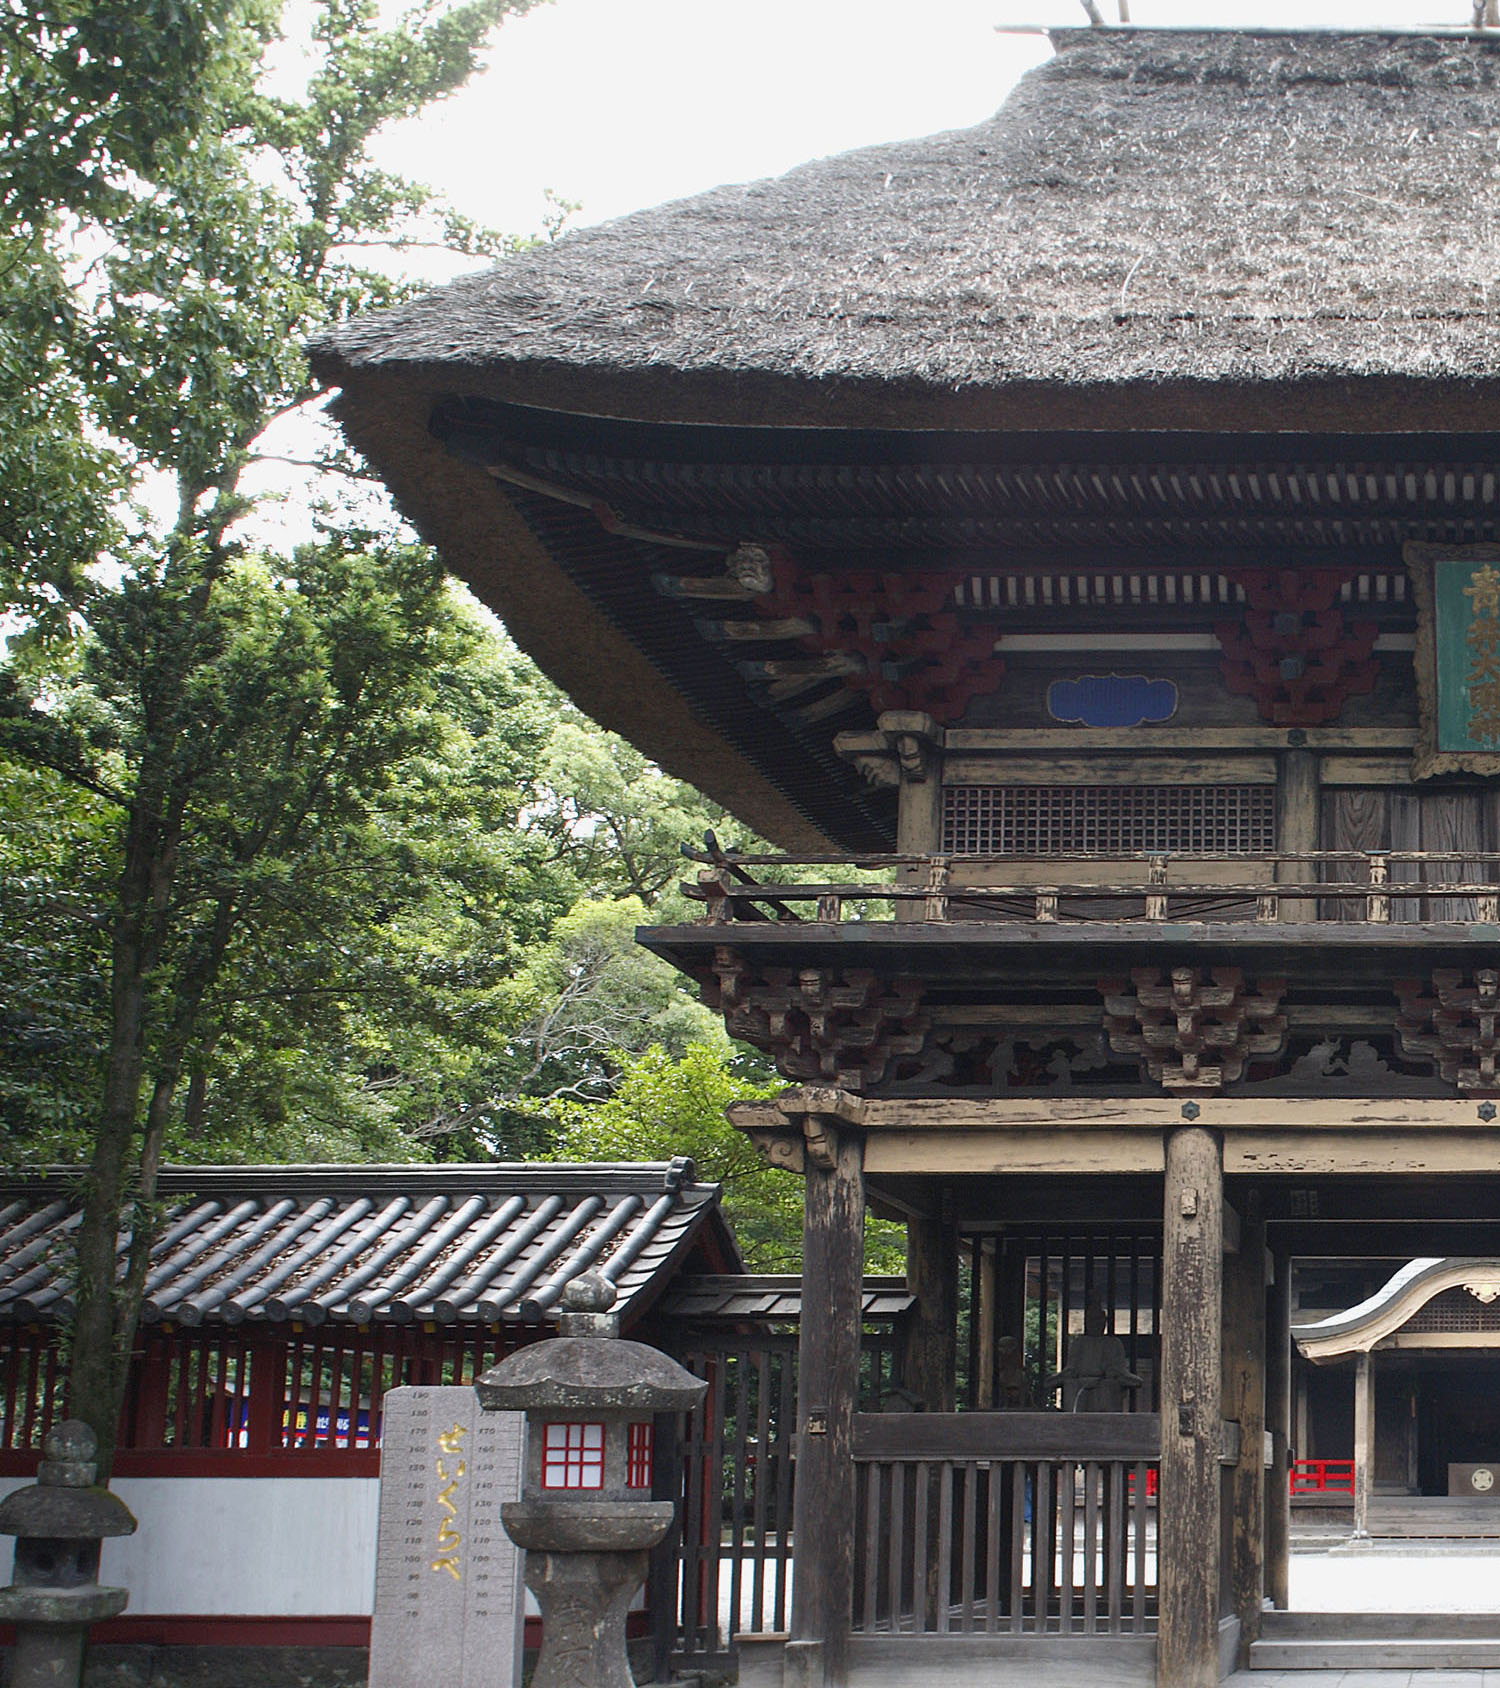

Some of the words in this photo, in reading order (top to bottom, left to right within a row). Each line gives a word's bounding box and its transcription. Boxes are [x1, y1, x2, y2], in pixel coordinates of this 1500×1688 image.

[431, 1422, 467, 1580] せいくらべ
